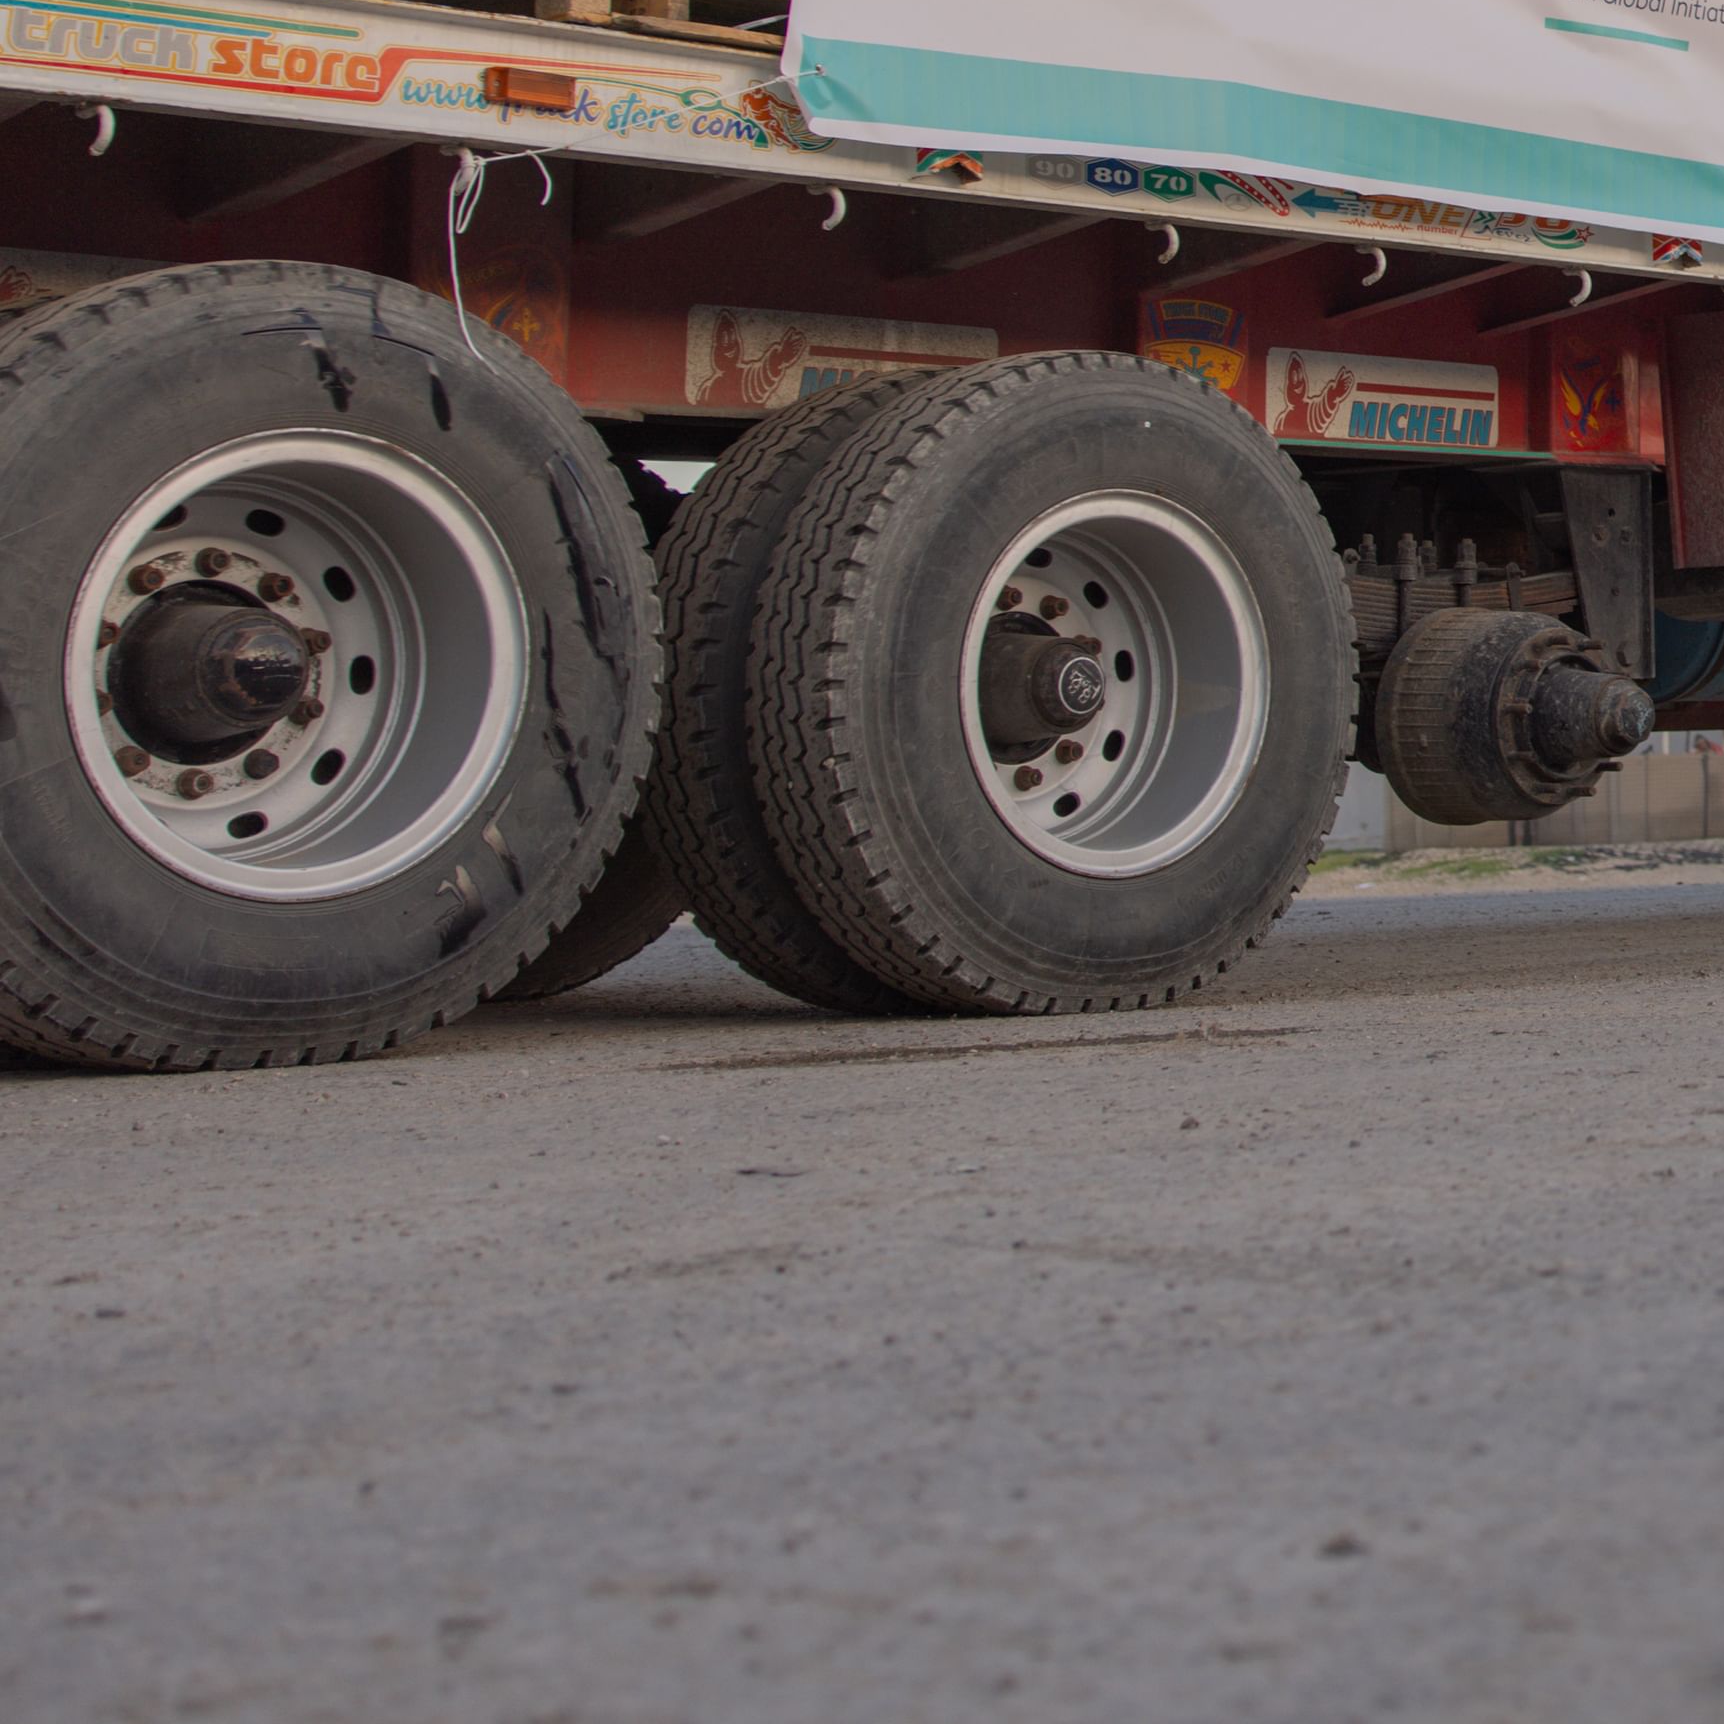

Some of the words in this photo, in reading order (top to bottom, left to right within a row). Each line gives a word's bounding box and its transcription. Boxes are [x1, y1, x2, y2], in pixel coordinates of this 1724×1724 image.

[10, 6, 197, 72] truck
[211, 38, 382, 92] store
[607, 92, 684, 135] store
[692, 111, 758, 142] com
[1035, 158, 1076, 179] 90
[1093, 165, 1133, 186] 80
[1149, 171, 1188, 193] 70
[1416, 224, 1459, 236] number
[1347, 400, 1494, 447] MICHELIN
